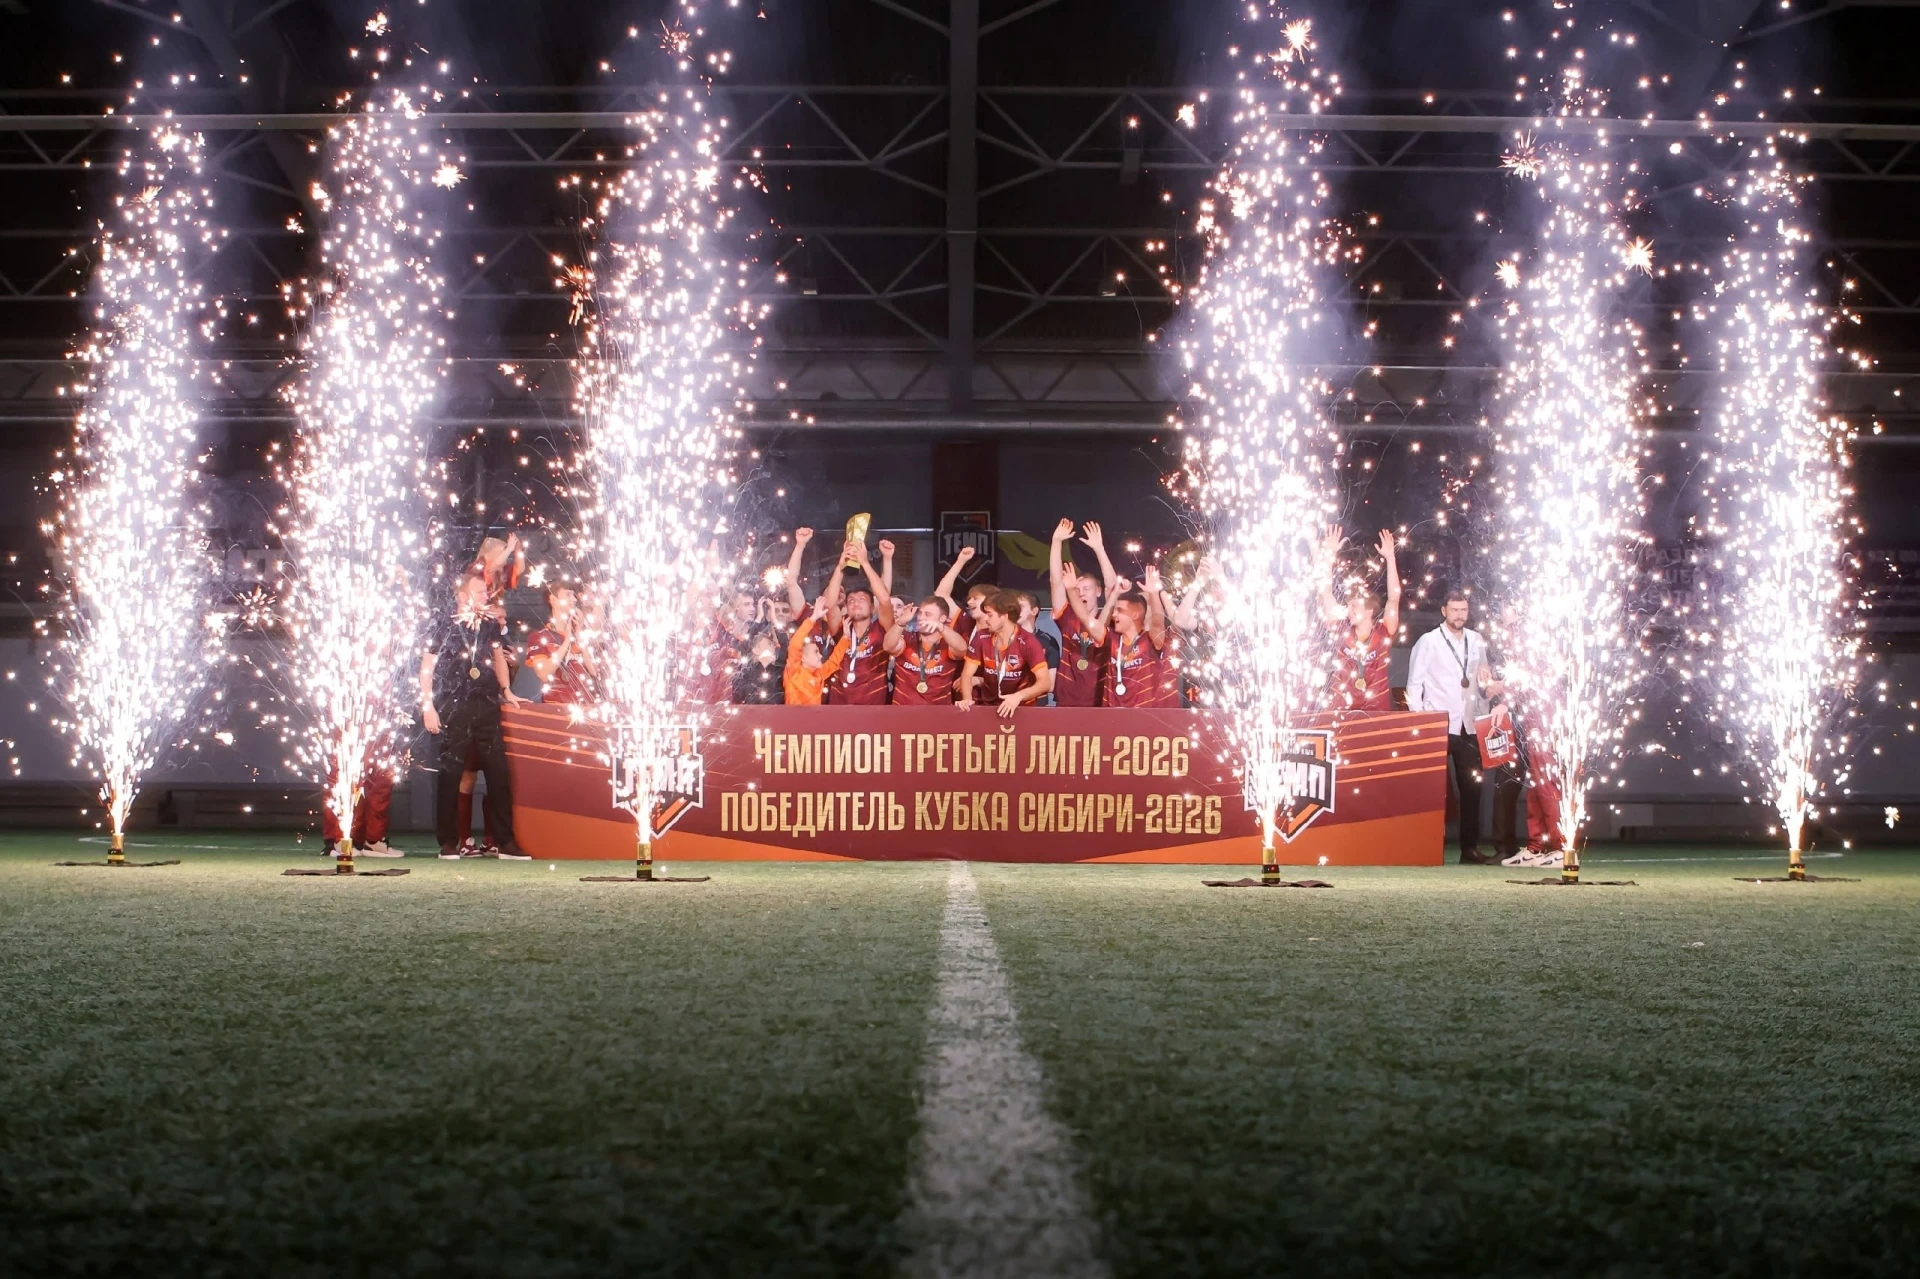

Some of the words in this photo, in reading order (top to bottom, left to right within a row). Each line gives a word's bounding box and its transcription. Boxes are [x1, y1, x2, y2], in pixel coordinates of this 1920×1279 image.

[754, 733, 892, 774] ЧЕМПИОН
[900, 724, 1016, 774] ТРЕТЬЕЙ
[1024, 735, 1189, 776] ЛИГИ-2026
[720, 791, 906, 838] ПОБЕДИТЕЛЬ
[914, 791, 1009, 832] КУБКА
[1018, 792, 1223, 835] СИБИРИ-2026
